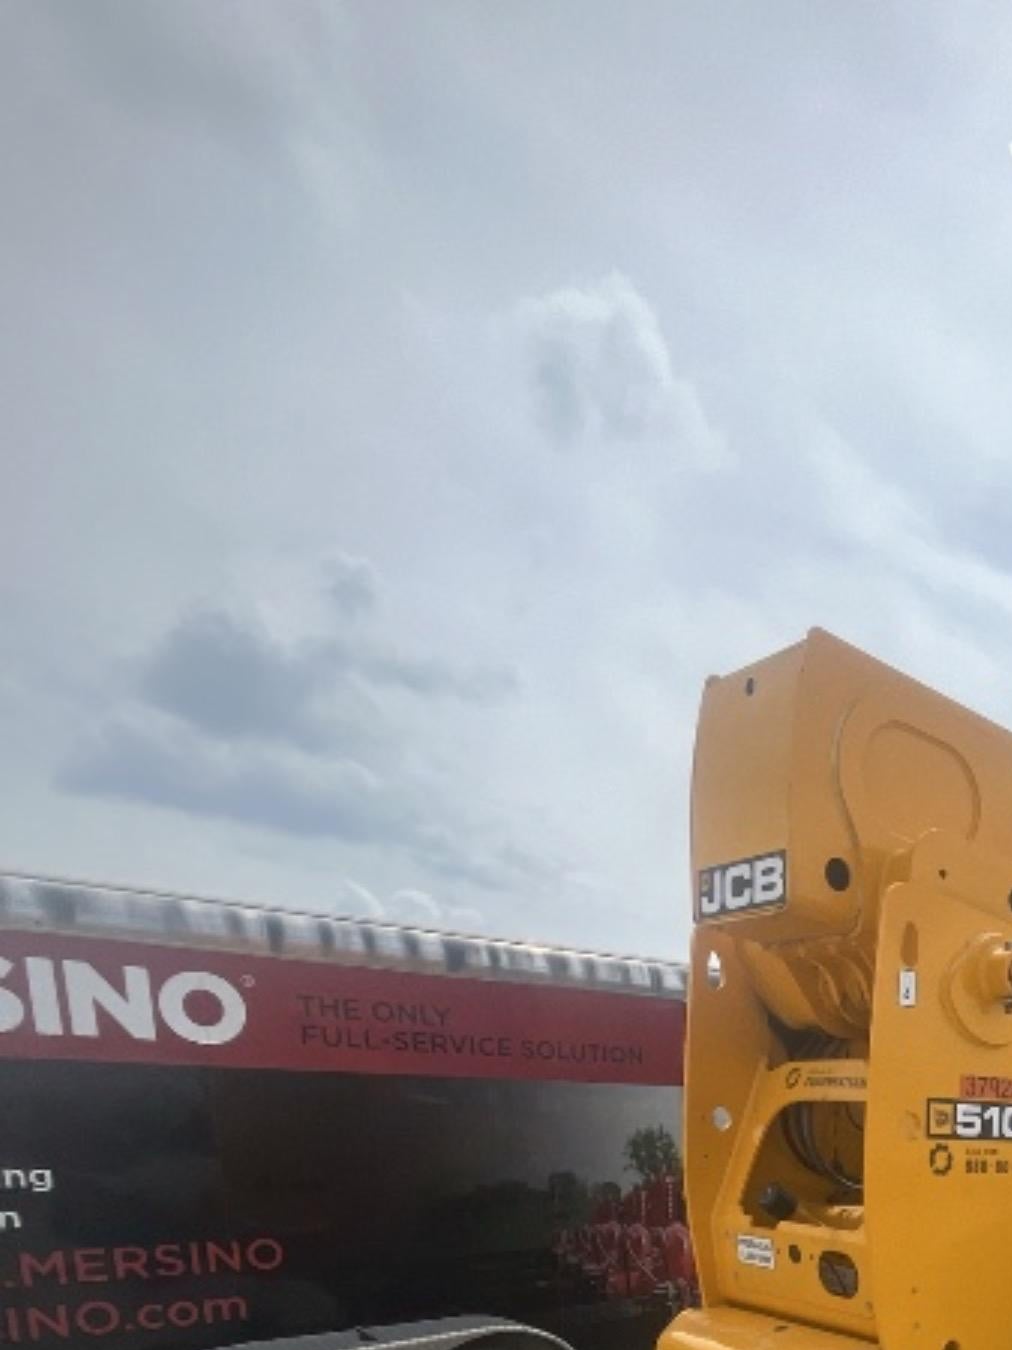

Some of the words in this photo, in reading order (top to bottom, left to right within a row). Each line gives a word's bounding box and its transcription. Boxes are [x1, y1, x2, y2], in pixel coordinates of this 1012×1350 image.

[701, 855, 784, 914] JCB
[297, 995, 359, 1022] THE
[371, 1000, 450, 1027] ONLY
[302, 1024, 512, 1058] FULL-SERVICE
[521, 1039, 643, 1066] SOLUTION
